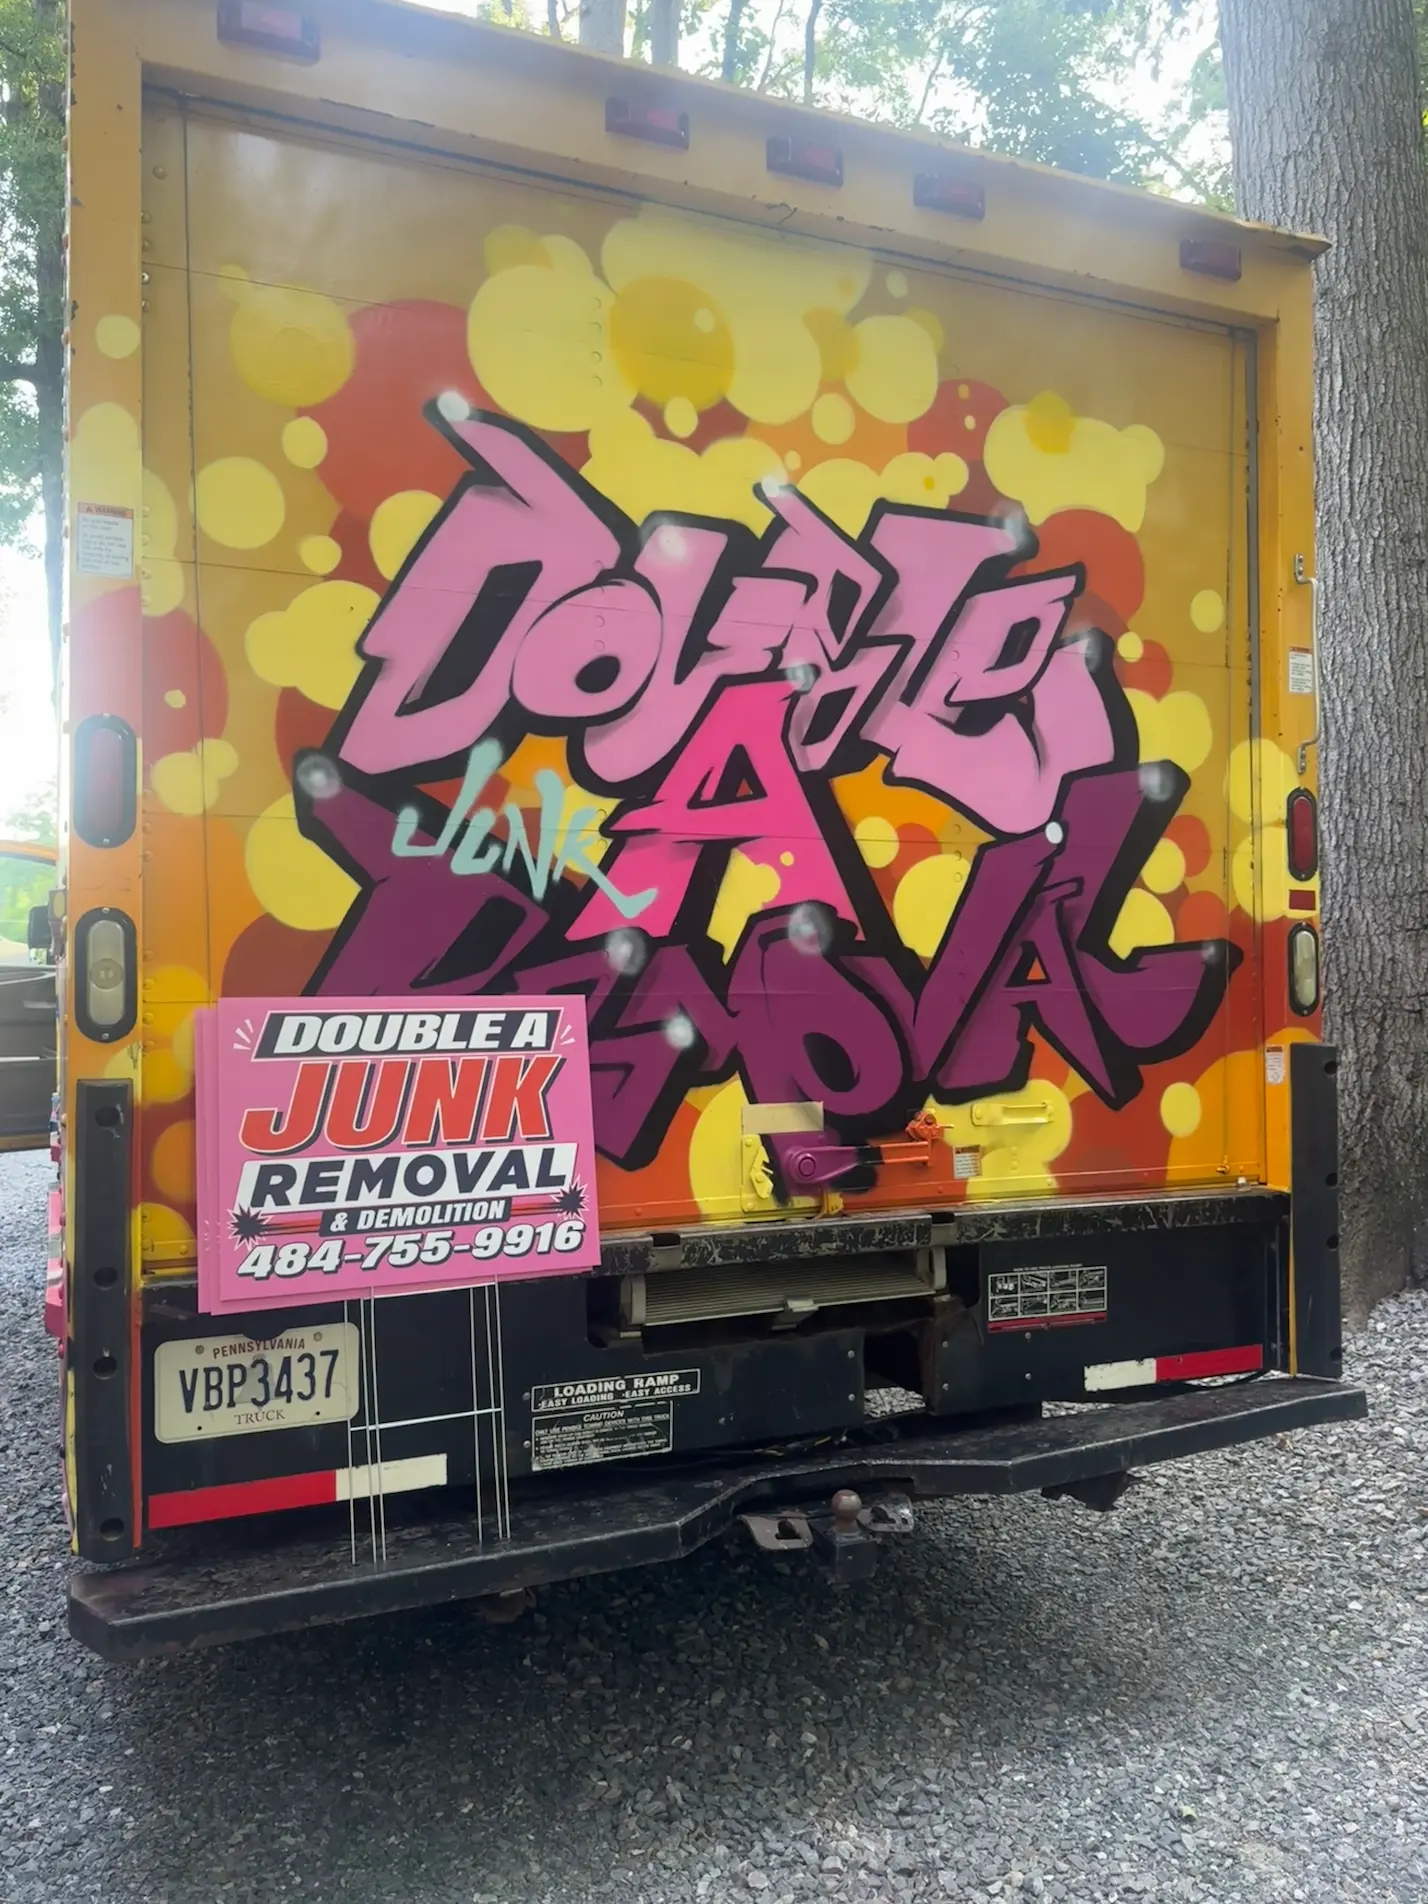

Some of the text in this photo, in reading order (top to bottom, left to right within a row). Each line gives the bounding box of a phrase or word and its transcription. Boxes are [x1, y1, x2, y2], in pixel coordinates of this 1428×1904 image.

[566, 676, 864, 942] A
[273, 1012, 549, 1054] DOUBLE A
[238, 1054, 567, 1156] JUNK
[249, 1148, 567, 1208] REMOVAL
[329, 1199, 506, 1232] & DEMOLITION
[237, 1220, 586, 1281] 484-755-9916
[212, 1338, 305, 1359] PENNSYLVANIA
[179, 1349, 339, 1414] VBP3437
[554, 1374, 680, 1398] LOADING RAMP
[571, 1392, 614, 1404] LOADING
[654, 1383, 691, 1395] ACCESS
[234, 1409, 285, 1425] TRUCK
[583, 1410, 625, 1422] CAUTION
